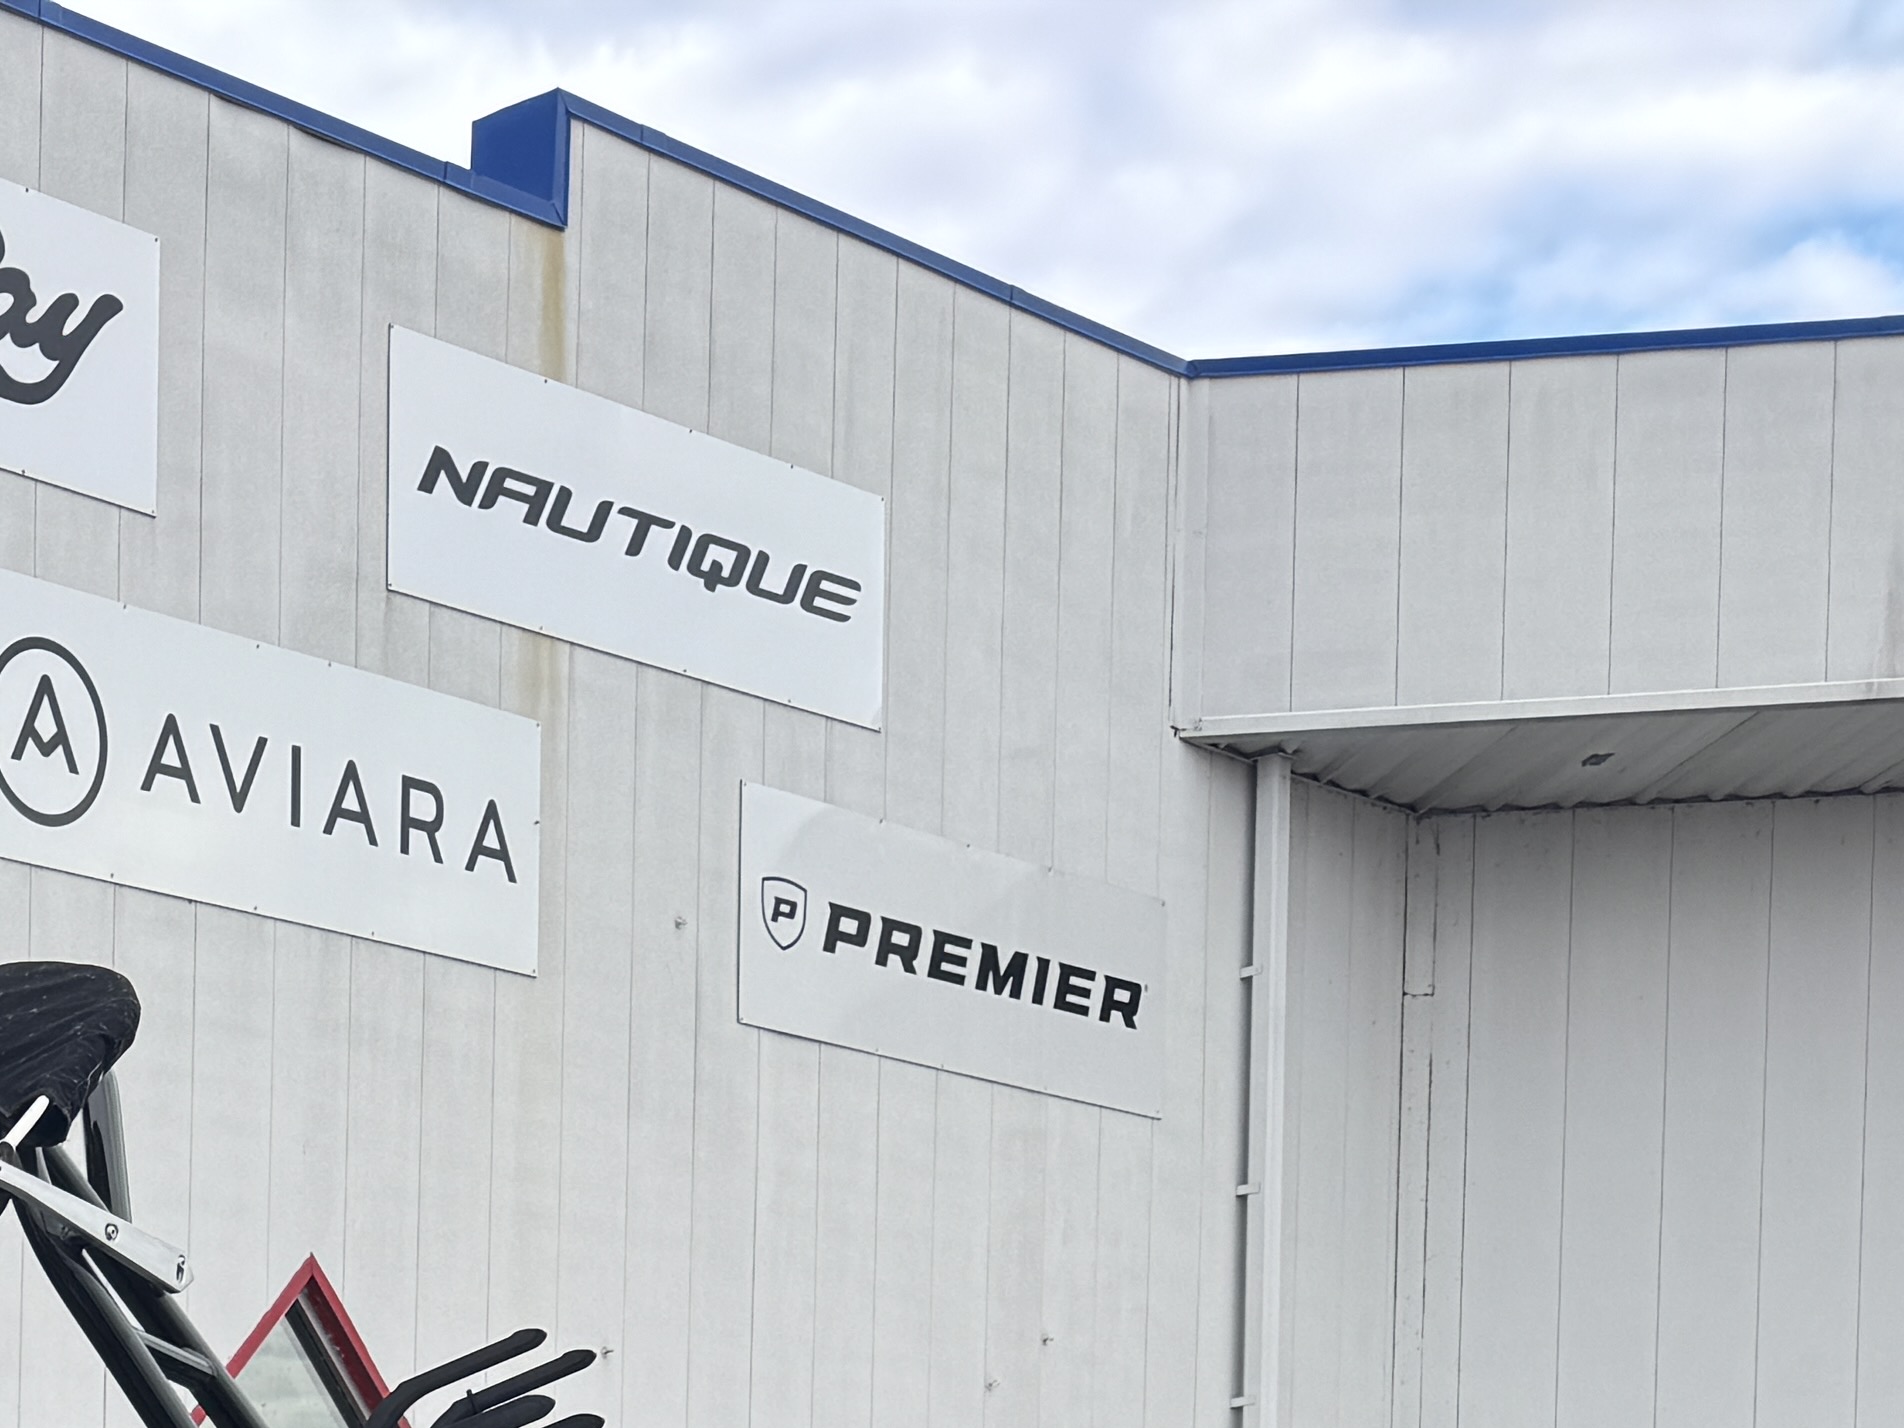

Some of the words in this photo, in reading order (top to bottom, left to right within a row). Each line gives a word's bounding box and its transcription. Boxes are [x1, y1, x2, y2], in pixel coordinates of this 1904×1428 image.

[417, 445, 863, 624] NAUTIQUE
[140, 712, 519, 884] AVIARA
[822, 902, 1143, 1030] PREMIER
